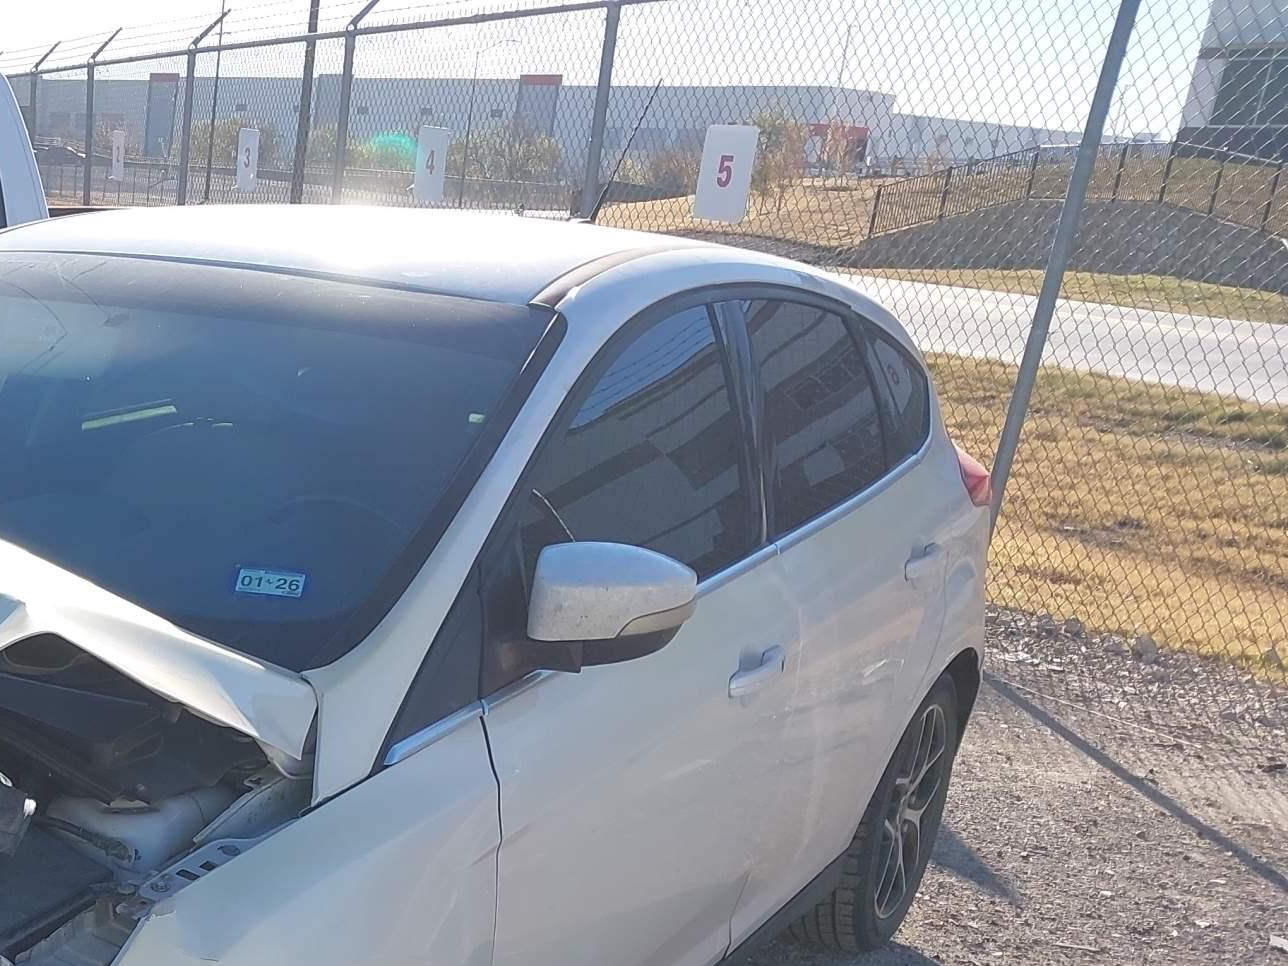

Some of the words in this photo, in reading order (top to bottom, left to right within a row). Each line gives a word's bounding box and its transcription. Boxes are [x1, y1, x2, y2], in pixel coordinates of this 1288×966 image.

[243, 147, 251, 169] 3
[425, 150, 436, 176] 4
[716, 154, 735, 188] 5
[240, 574, 264, 588] 01
[274, 577, 301, 592] 26
